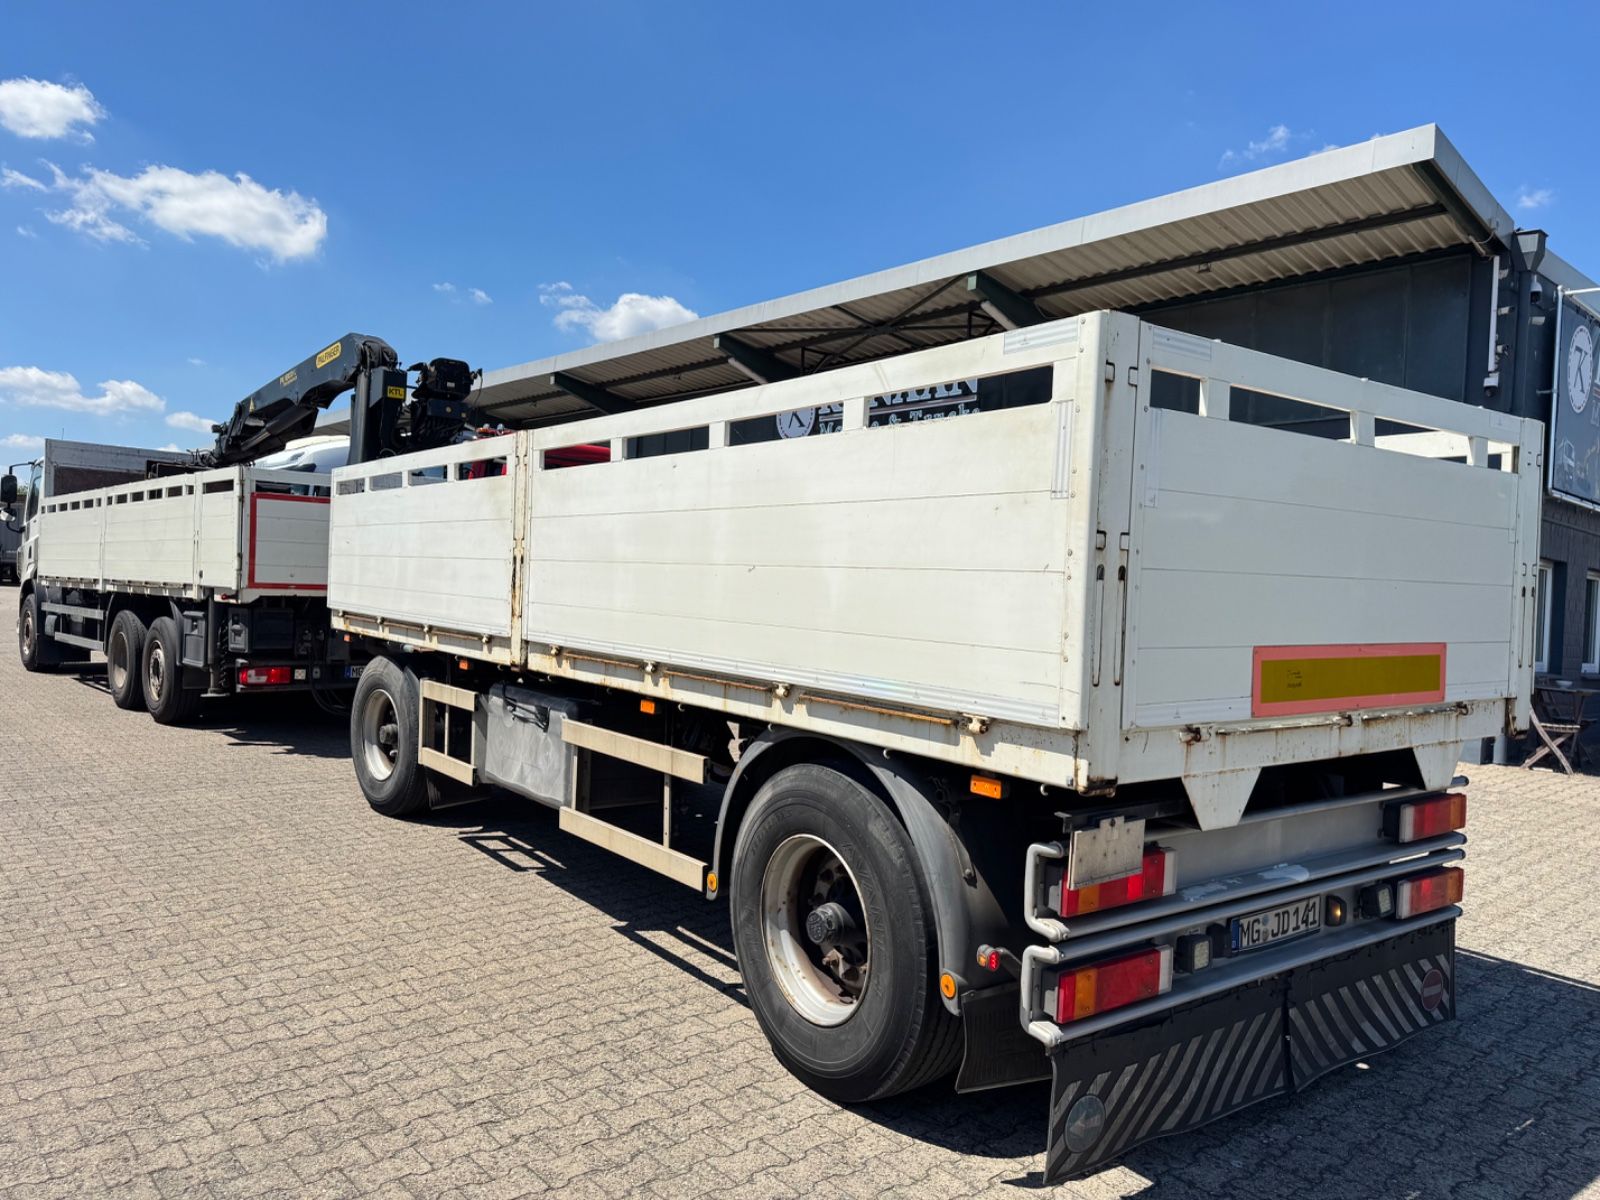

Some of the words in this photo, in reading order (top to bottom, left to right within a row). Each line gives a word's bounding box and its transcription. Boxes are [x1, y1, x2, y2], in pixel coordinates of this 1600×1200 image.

[388, 388, 404, 397] KTL
[1239, 918, 1261, 948] MG
[1271, 910, 1290, 938] JD
[1292, 900, 1318, 932] 141
